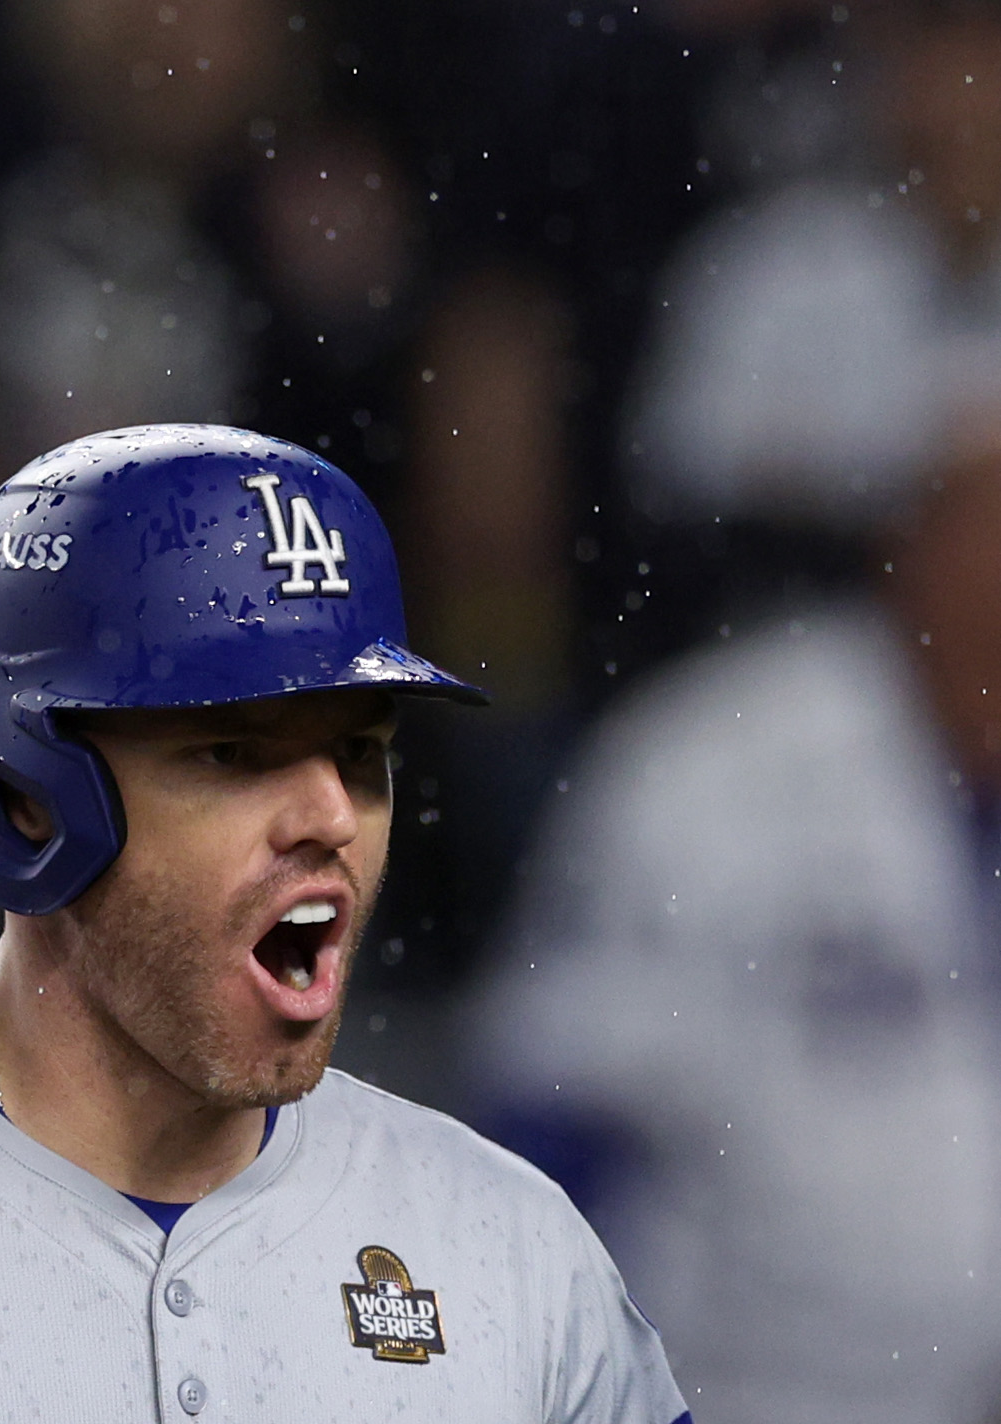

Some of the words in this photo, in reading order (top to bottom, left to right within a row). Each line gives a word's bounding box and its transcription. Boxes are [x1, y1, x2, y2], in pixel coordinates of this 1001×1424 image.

[243, 473, 350, 594] LA
[350, 1293, 435, 1319] WORLD
[359, 1314, 436, 1340] SERIES
